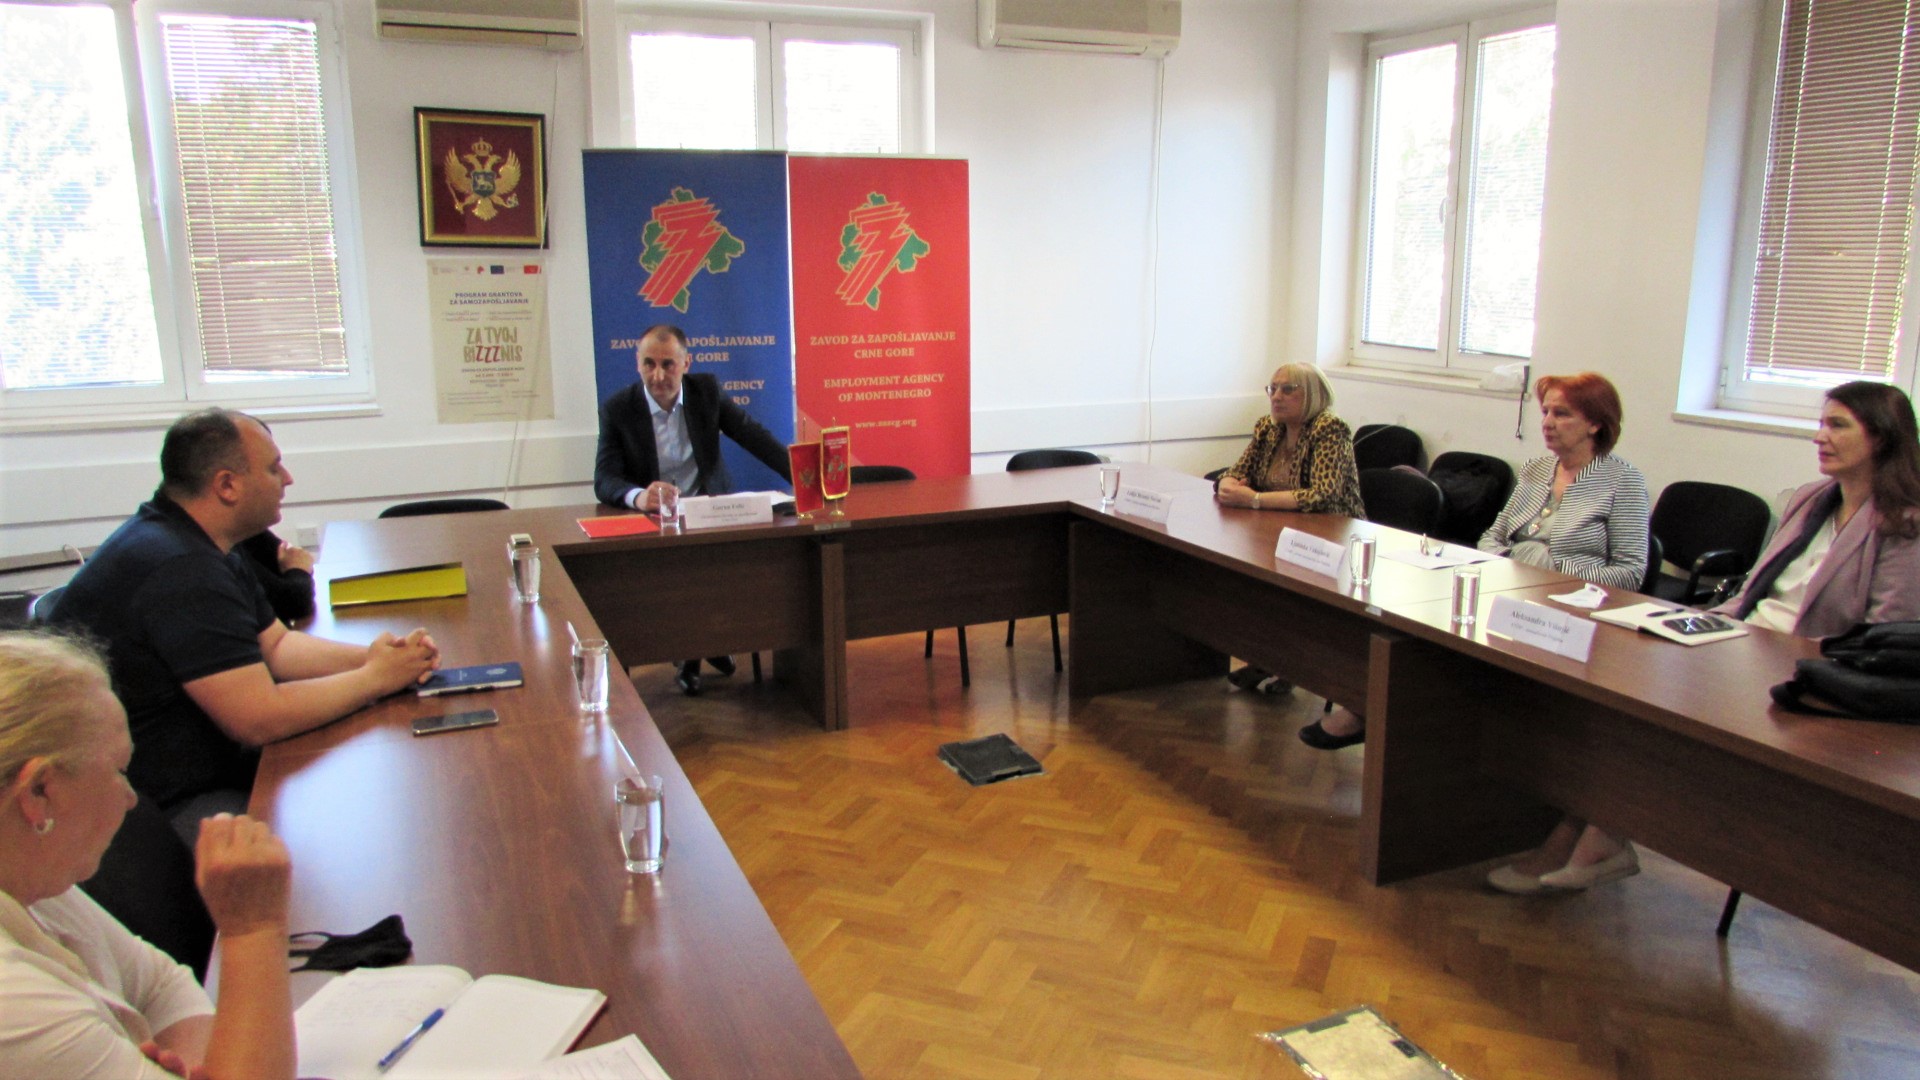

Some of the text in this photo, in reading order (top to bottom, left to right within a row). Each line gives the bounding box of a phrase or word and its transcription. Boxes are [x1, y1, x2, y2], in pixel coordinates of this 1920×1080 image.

[466, 326, 518, 344] ZA TVOJ
[686, 334, 776, 348] APOŠLJAVANJE
[810, 331, 956, 346] ZAVOD ZA ZAPOŠLJAVANJE
[696, 352, 730, 362] GORE
[854, 348, 915, 359] CRNE GORE
[722, 380, 765, 391] GENCY
[824, 374, 944, 388] EMPLOYMENT AGENCY
[838, 388, 932, 402] OF MONTENEGRO
